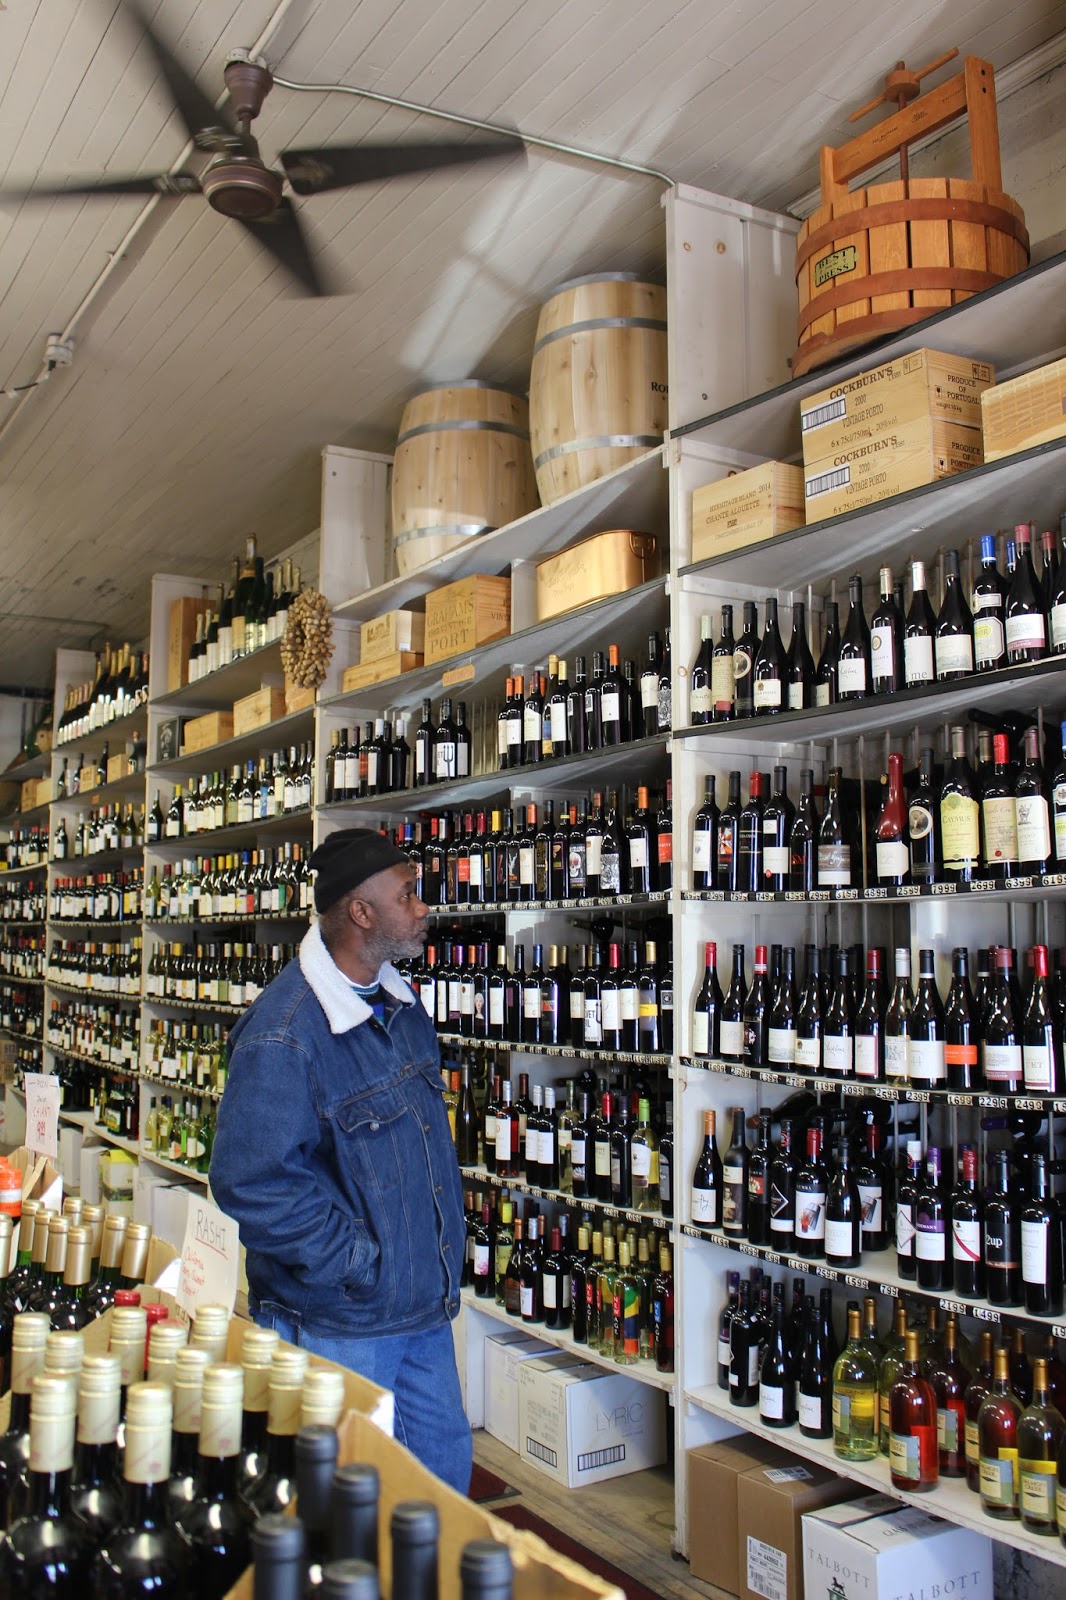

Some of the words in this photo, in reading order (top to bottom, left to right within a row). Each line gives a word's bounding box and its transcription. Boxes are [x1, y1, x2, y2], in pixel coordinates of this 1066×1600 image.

[829, 366, 894, 400] COCKBURN'S
[947, 375, 976, 387] PRODUCE
[946, 392, 980, 405] PORTUGAL
[842, 410, 866, 428] VINTAGE
[866, 403, 884, 419] PORTO
[833, 436, 897, 467] COCKBURN'S
[951, 442, 981, 455] PRODUCE
[962, 453, 971, 461] OF
[845, 477, 868, 495] VINTAGE
[868, 472, 887, 487] PORTO
[705, 511, 729, 524] CHANTE
[730, 500, 760, 516] ALOUETTE
[709, 496, 738, 512] HERMITAGE
[430, 629, 469, 654] PORT
[942, 815, 971, 824] CAYMUS
[932, 884, 956, 894] 7999
[971, 881, 994, 891] 2699
[980, 1097, 1008, 1108] 2299
[1016, 1100, 1042, 1110] 2499
[196, 1208, 226, 1251] RASHI
[940, 1299, 965, 1314] 2199
[974, 1307, 1000, 1323] 1499
[595, 1402, 643, 1432] LYRIC
[808, 1548, 871, 1589] TALBOTT
